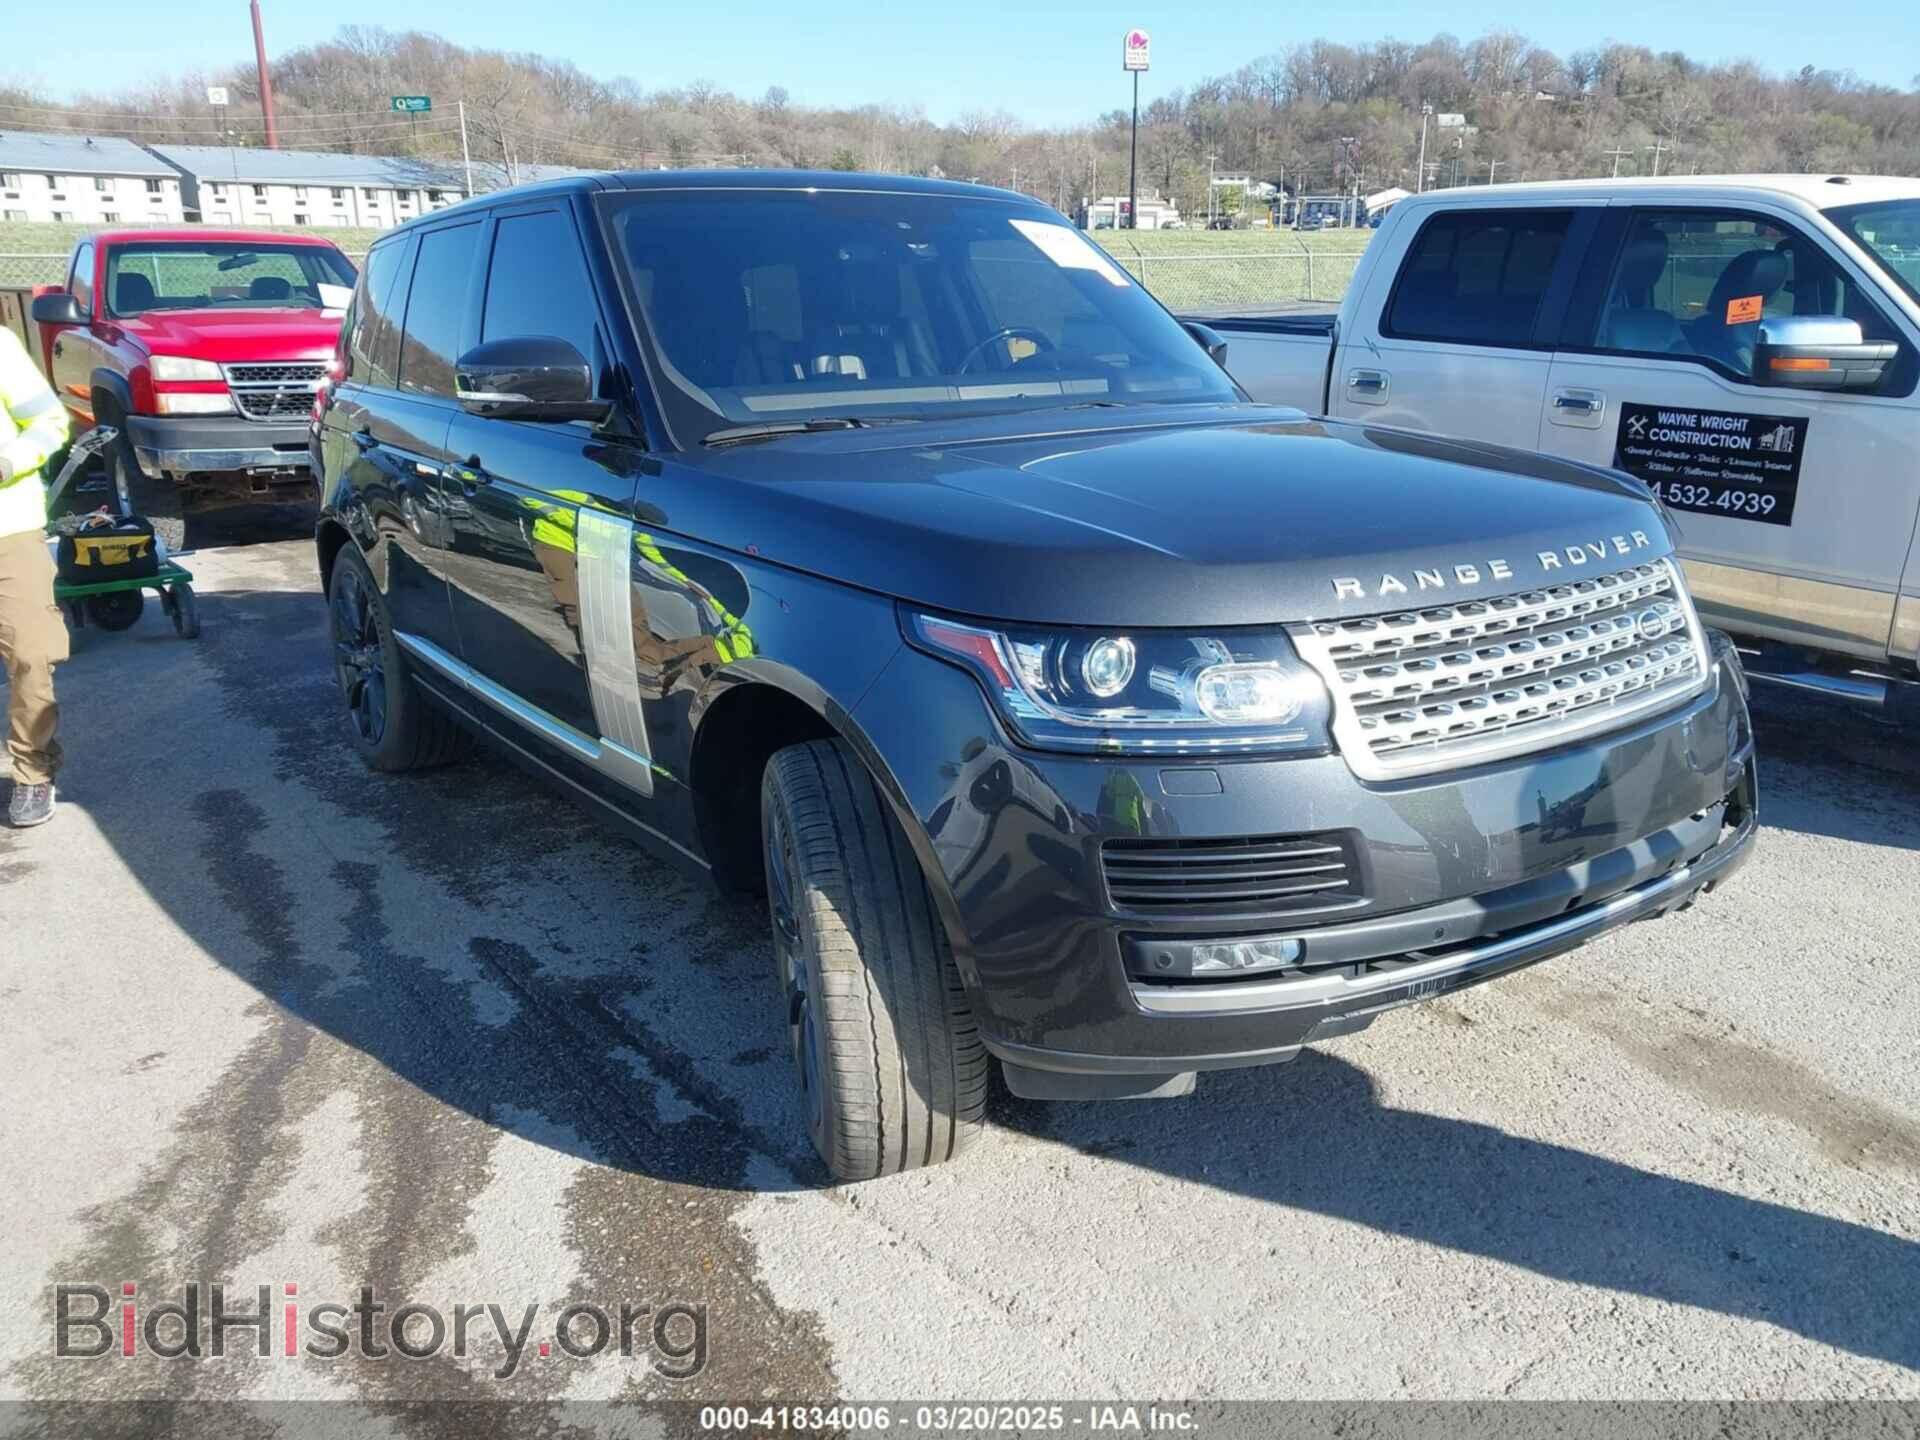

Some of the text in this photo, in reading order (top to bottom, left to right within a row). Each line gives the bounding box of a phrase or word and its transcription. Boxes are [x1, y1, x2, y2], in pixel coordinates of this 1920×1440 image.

[1657, 411, 1749, 432] WAYNE WRIGHT
[1649, 428, 1752, 450] CONSTRUCTION
[1642, 480, 1777, 515] 4-532-4939
[1331, 529, 1651, 601] RANGE ROVER
